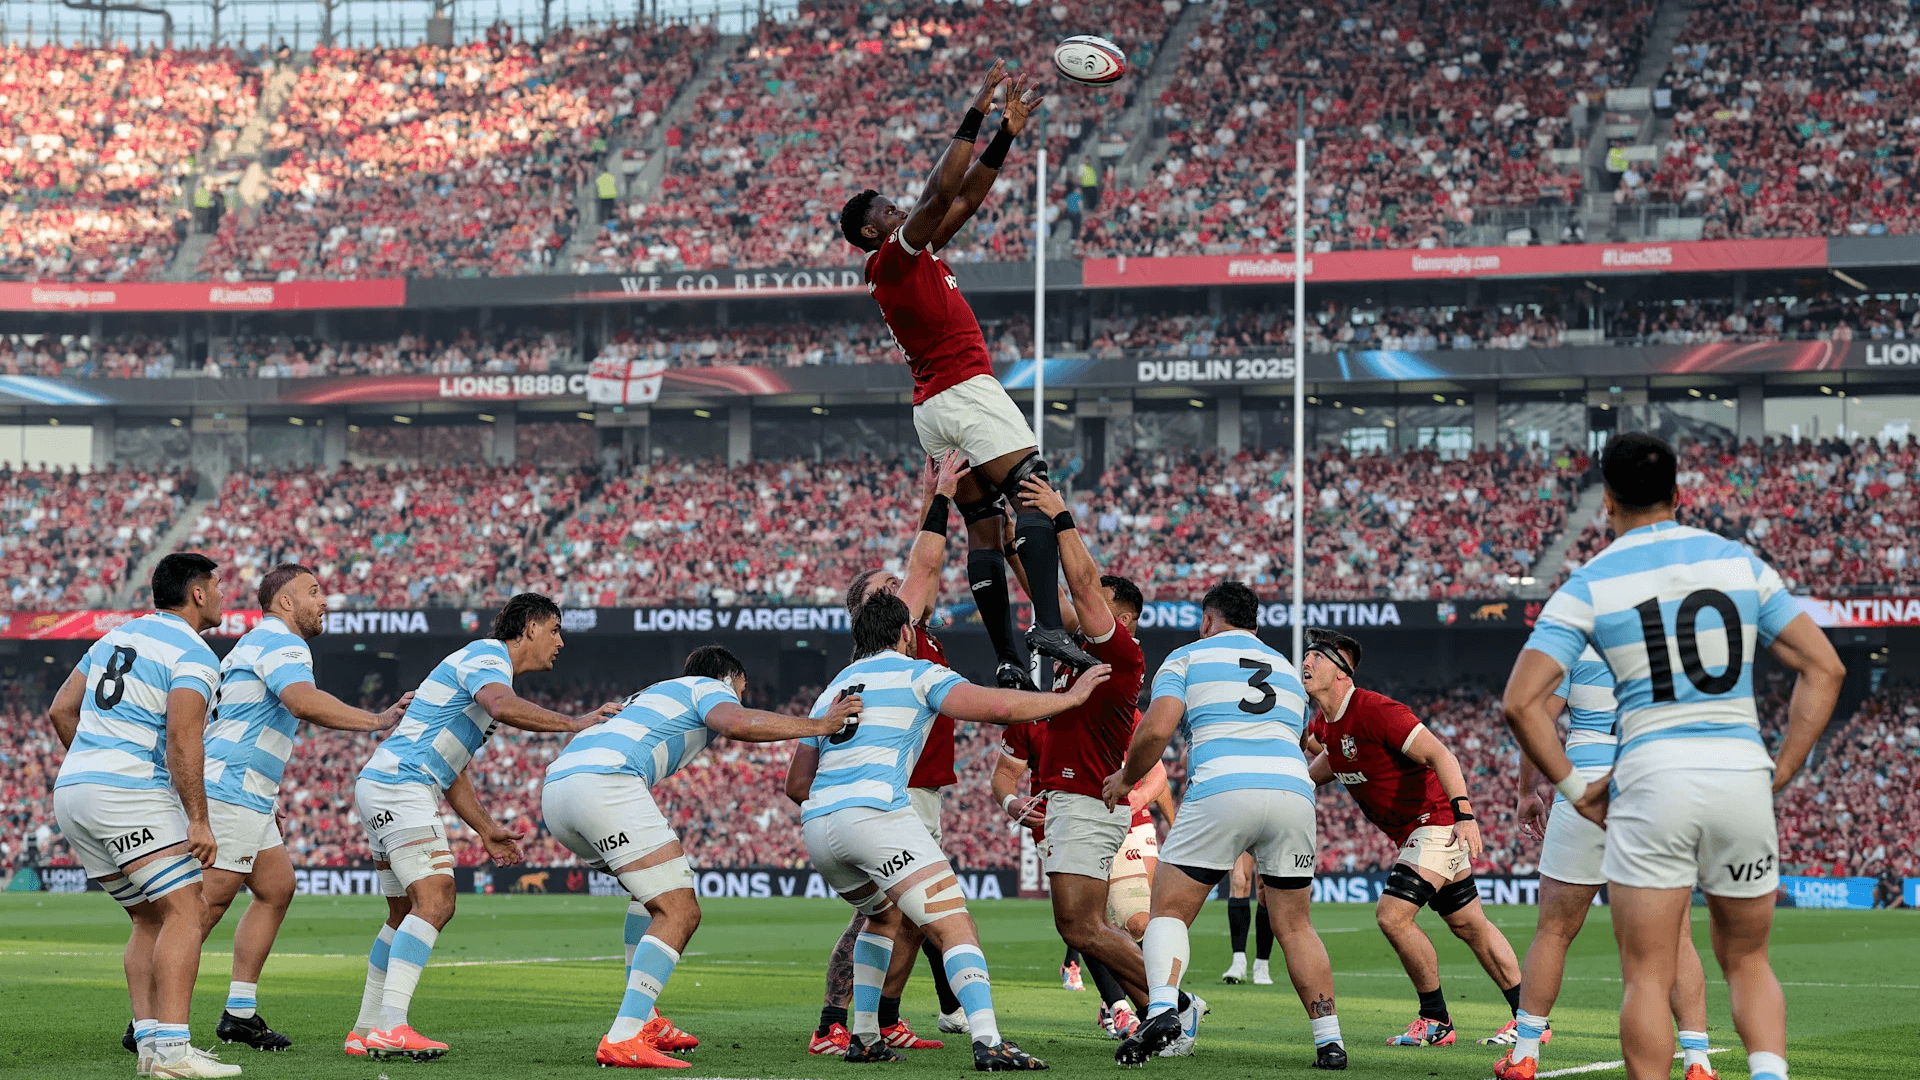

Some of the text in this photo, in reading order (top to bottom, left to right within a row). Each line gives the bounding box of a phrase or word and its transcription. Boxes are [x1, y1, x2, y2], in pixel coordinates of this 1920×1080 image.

[620, 271, 860, 295] WE GO BEYOND
[1137, 358, 1297, 383] DUBLIN 2025
[439, 375, 510, 397] LIONS
[512, 374, 567, 396] 1888
[633, 608, 714, 632] LIONS
[1137, 603, 1199, 628] ONS
[1634, 588, 1744, 703] 10
[94, 645, 138, 711] 8
[1237, 657, 1277, 715] 3
[367, 810, 394, 831] VISA
[111, 827, 155, 854] VISA
[594, 832, 630, 853] VISA
[876, 850, 916, 878] VISA
[1724, 854, 1774, 882] VISA
[1794, 880, 1849, 898] LIONS
